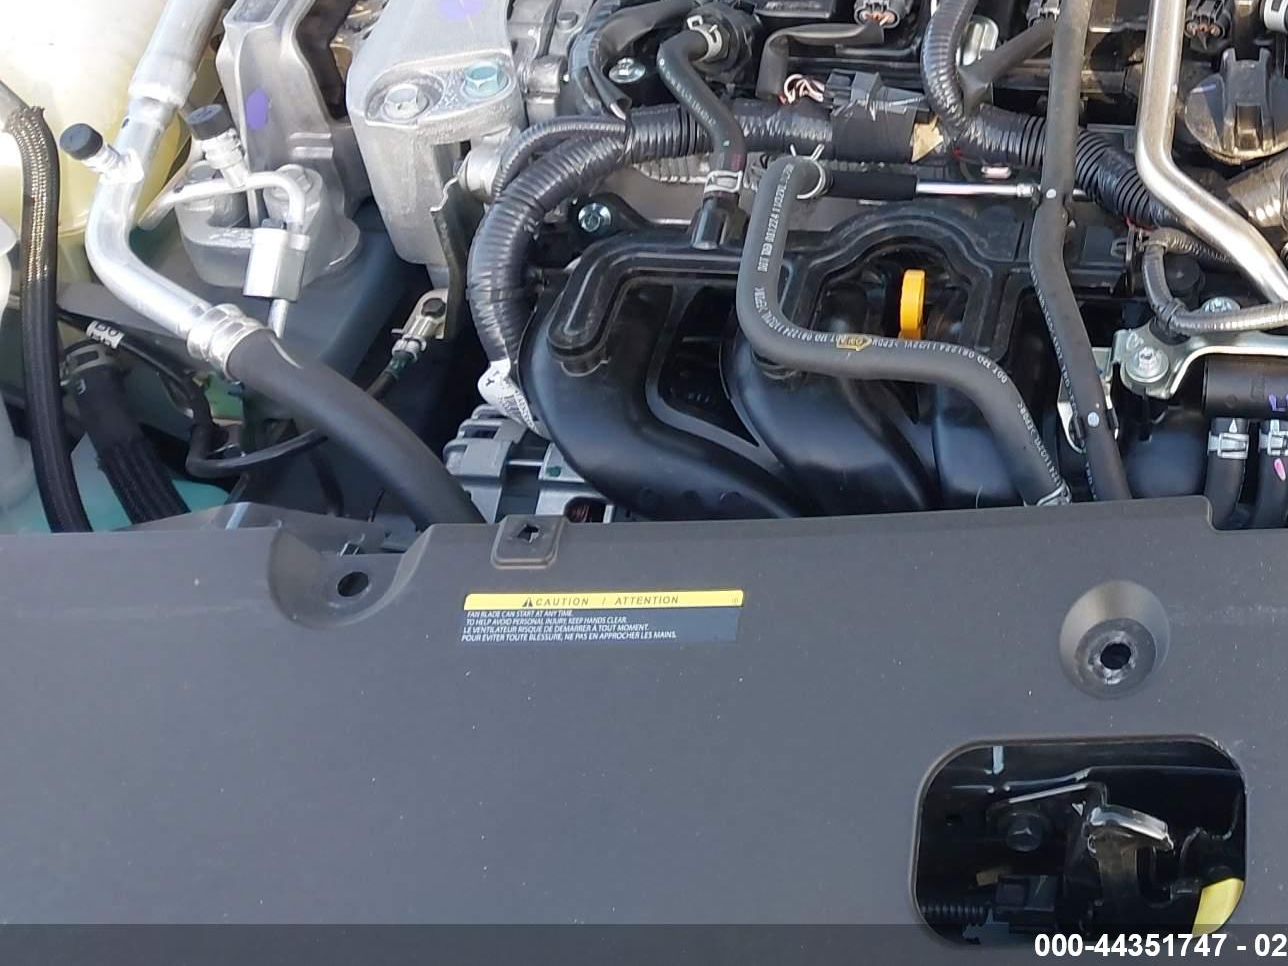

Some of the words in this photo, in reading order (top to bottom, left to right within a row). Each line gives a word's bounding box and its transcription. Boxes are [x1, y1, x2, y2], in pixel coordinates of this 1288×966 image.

[535, 597, 590, 607] CAUTION
[615, 595, 680, 606] ATTENTION
[501, 610, 516, 618] CAN
[516, 610, 535, 618] START
[466, 618, 475, 626] TO
[512, 617, 544, 625] PERSONAL
[568, 617, 584, 625] KEEP
[583, 616, 606, 624] HANDS
[472, 625, 517, 634] VENTILATEUR
[518, 625, 543, 633] RISQUE
[544, 625, 553, 633] DE
[598, 624, 616, 632] TOUT
[461, 634, 482, 642] POUR
[505, 634, 528, 642] TOUTE
[564, 633, 575, 641] NE
[575, 632, 588, 641] PAS
[588, 632, 599, 641] EN
[599, 631, 641, 640] APPROCHER
[640, 631, 653, 639] LES
